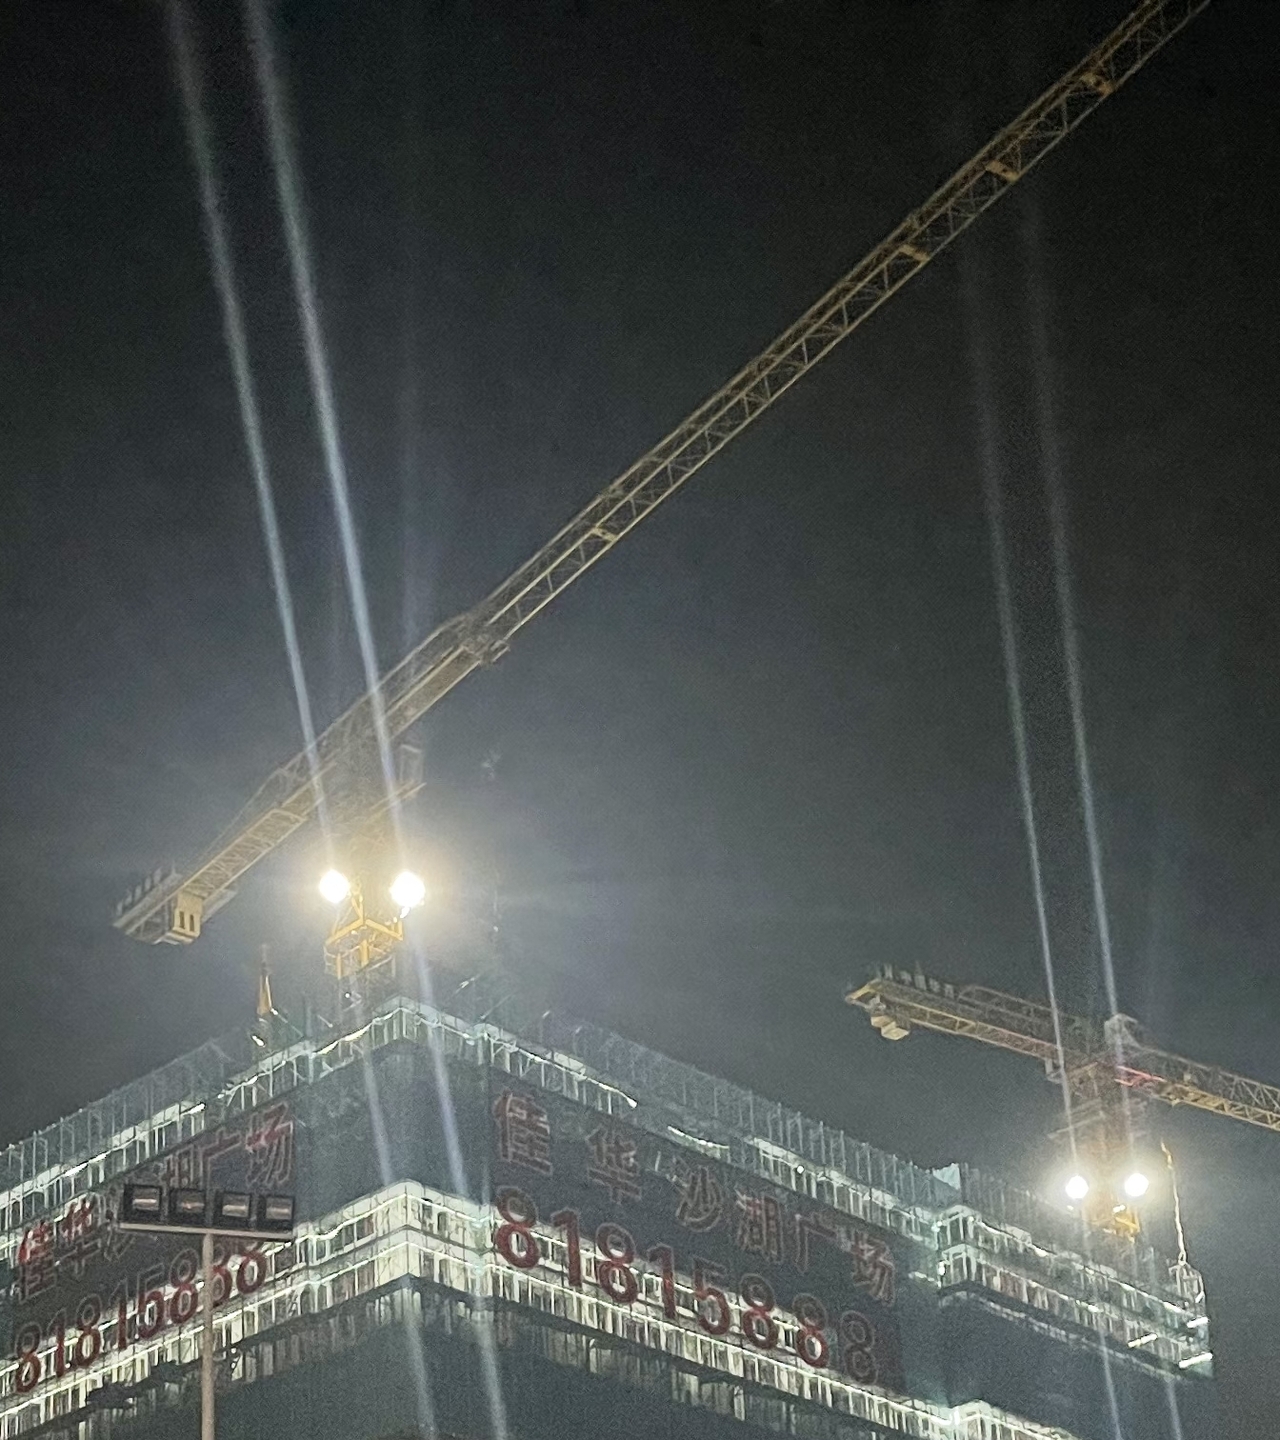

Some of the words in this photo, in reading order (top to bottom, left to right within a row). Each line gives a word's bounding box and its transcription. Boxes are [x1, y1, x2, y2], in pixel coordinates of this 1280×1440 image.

[492, 1089, 897, 1304] 佳华沙湖广场
[493, 1187, 880, 1385] 81815888
